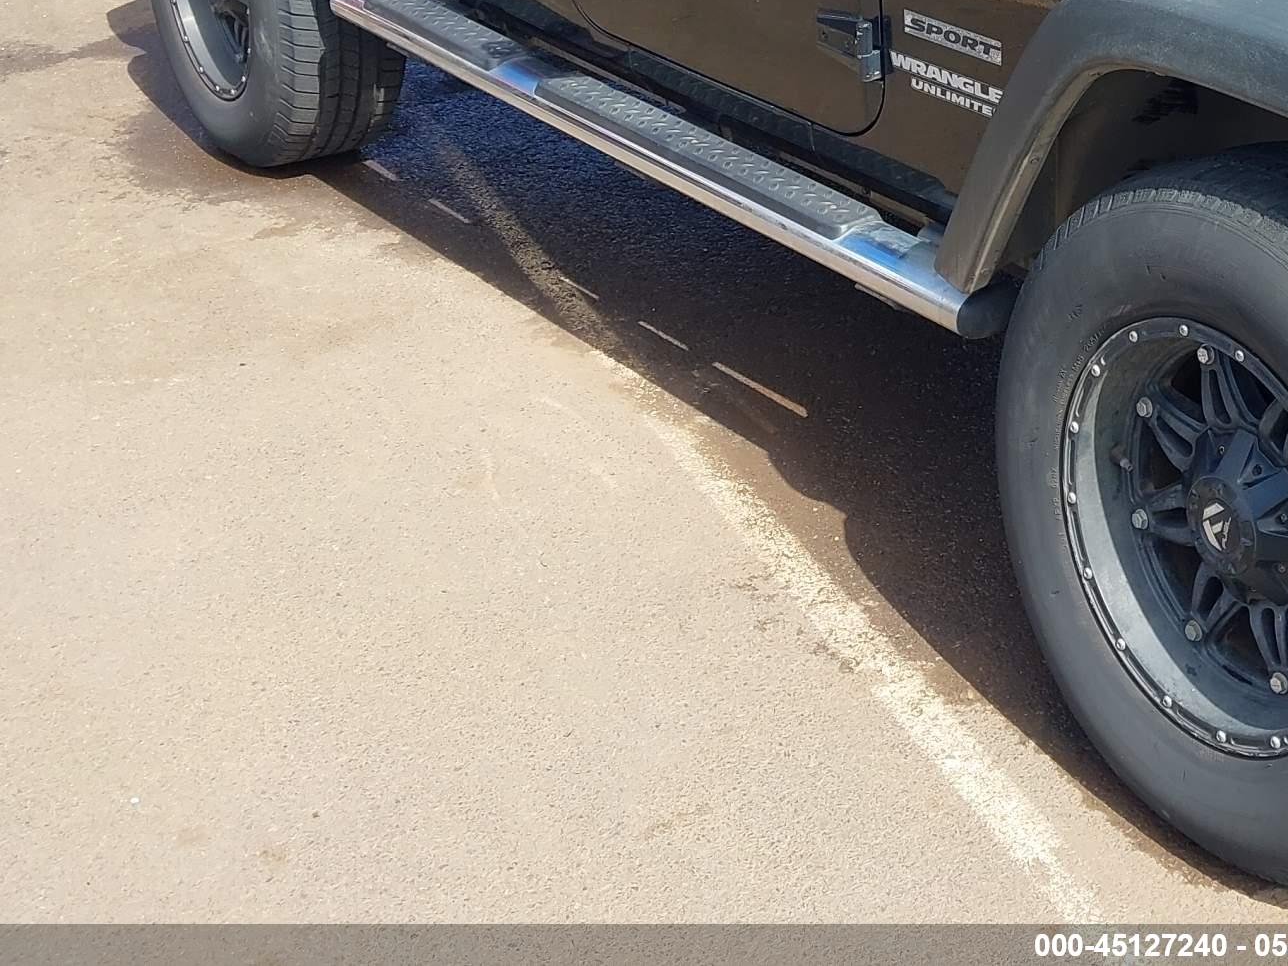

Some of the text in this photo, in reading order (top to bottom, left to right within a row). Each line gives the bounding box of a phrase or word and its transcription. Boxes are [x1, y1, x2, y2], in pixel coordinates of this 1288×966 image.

[905, 16, 1001, 55] SPORT
[889, 50, 1004, 103] WRANGLE
[910, 77, 996, 117] UNLIMITE
